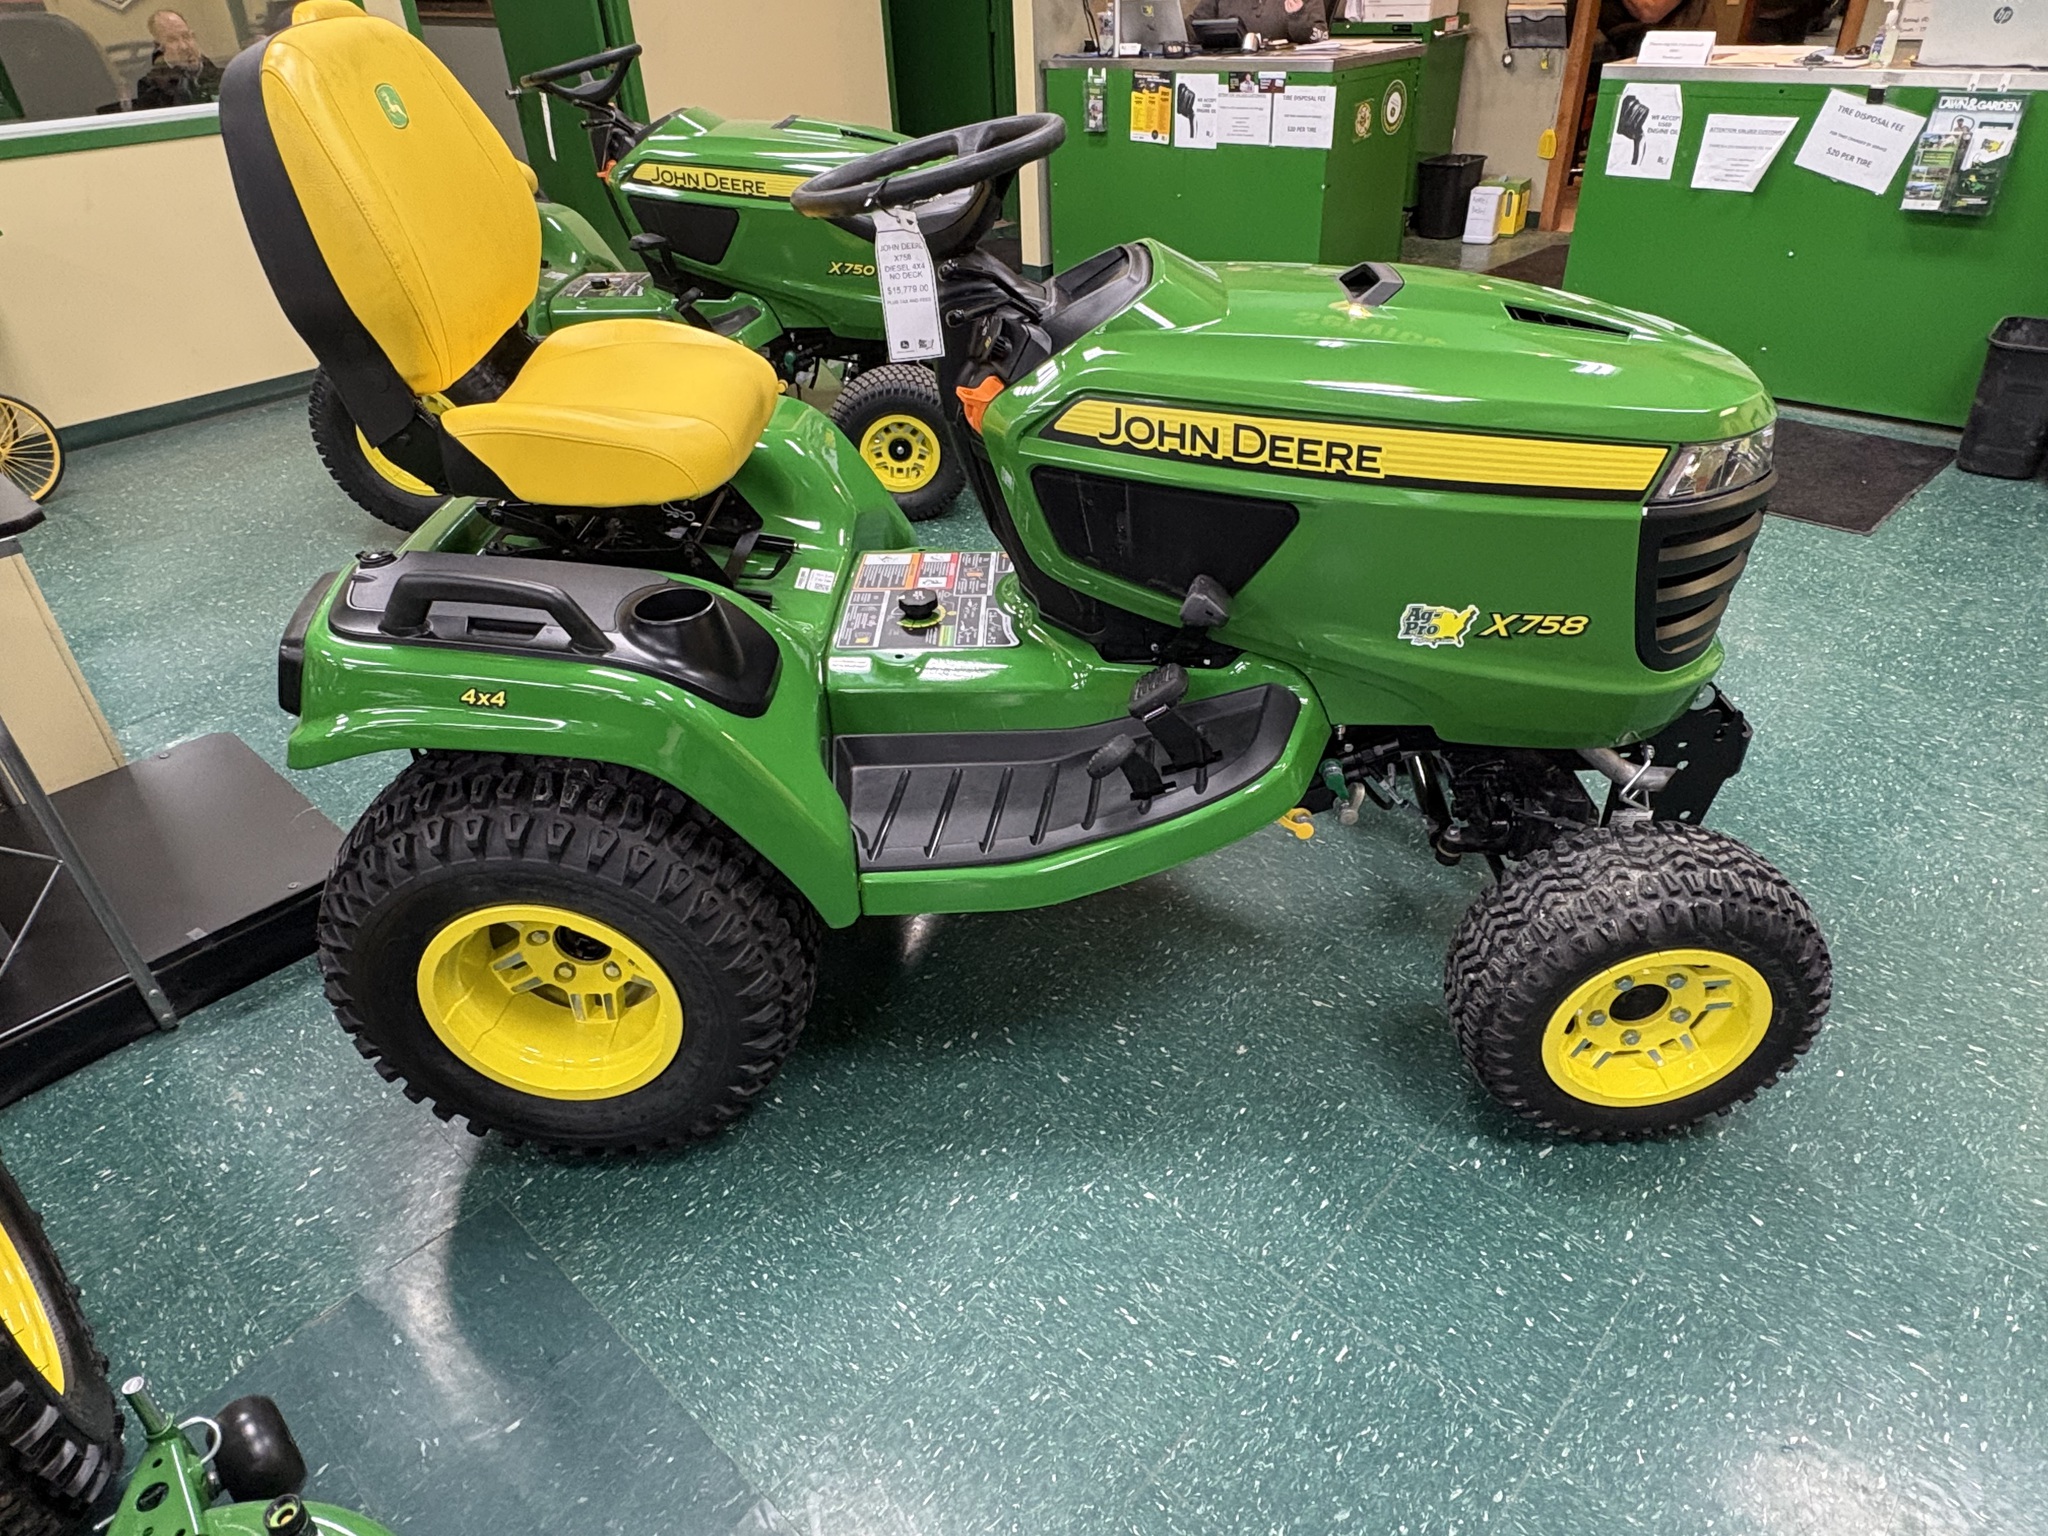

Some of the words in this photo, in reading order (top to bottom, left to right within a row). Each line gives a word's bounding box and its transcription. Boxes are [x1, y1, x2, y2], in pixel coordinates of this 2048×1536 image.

[1838, 104, 1855, 117] TIRE
[1854, 110, 1890, 128] DISPOSAL
[1890, 121, 1906, 133] FEE
[1826, 147, 1840, 157] $20
[1840, 152, 1854, 162] PER
[1856, 157, 1873, 168] TIRE
[651, 166, 700, 188] JOHN
[703, 172, 768, 196] DEERE
[880, 243, 899, 252] JOHN
[884, 264, 910, 273] DIESEL
[912, 261, 926, 270] 4X4
[893, 254, 911, 262] X758
[827, 260, 876, 276] X750
[902, 271, 923, 280] DECK
[1098, 407, 1220, 456] JOHN
[1231, 422, 1384, 475] DEERE
[1405, 606, 1443, 624] Ag-
[1402, 621, 1441, 637] Pro
[1477, 611, 1591, 638] X758
[459, 687, 507, 708] 4x4
